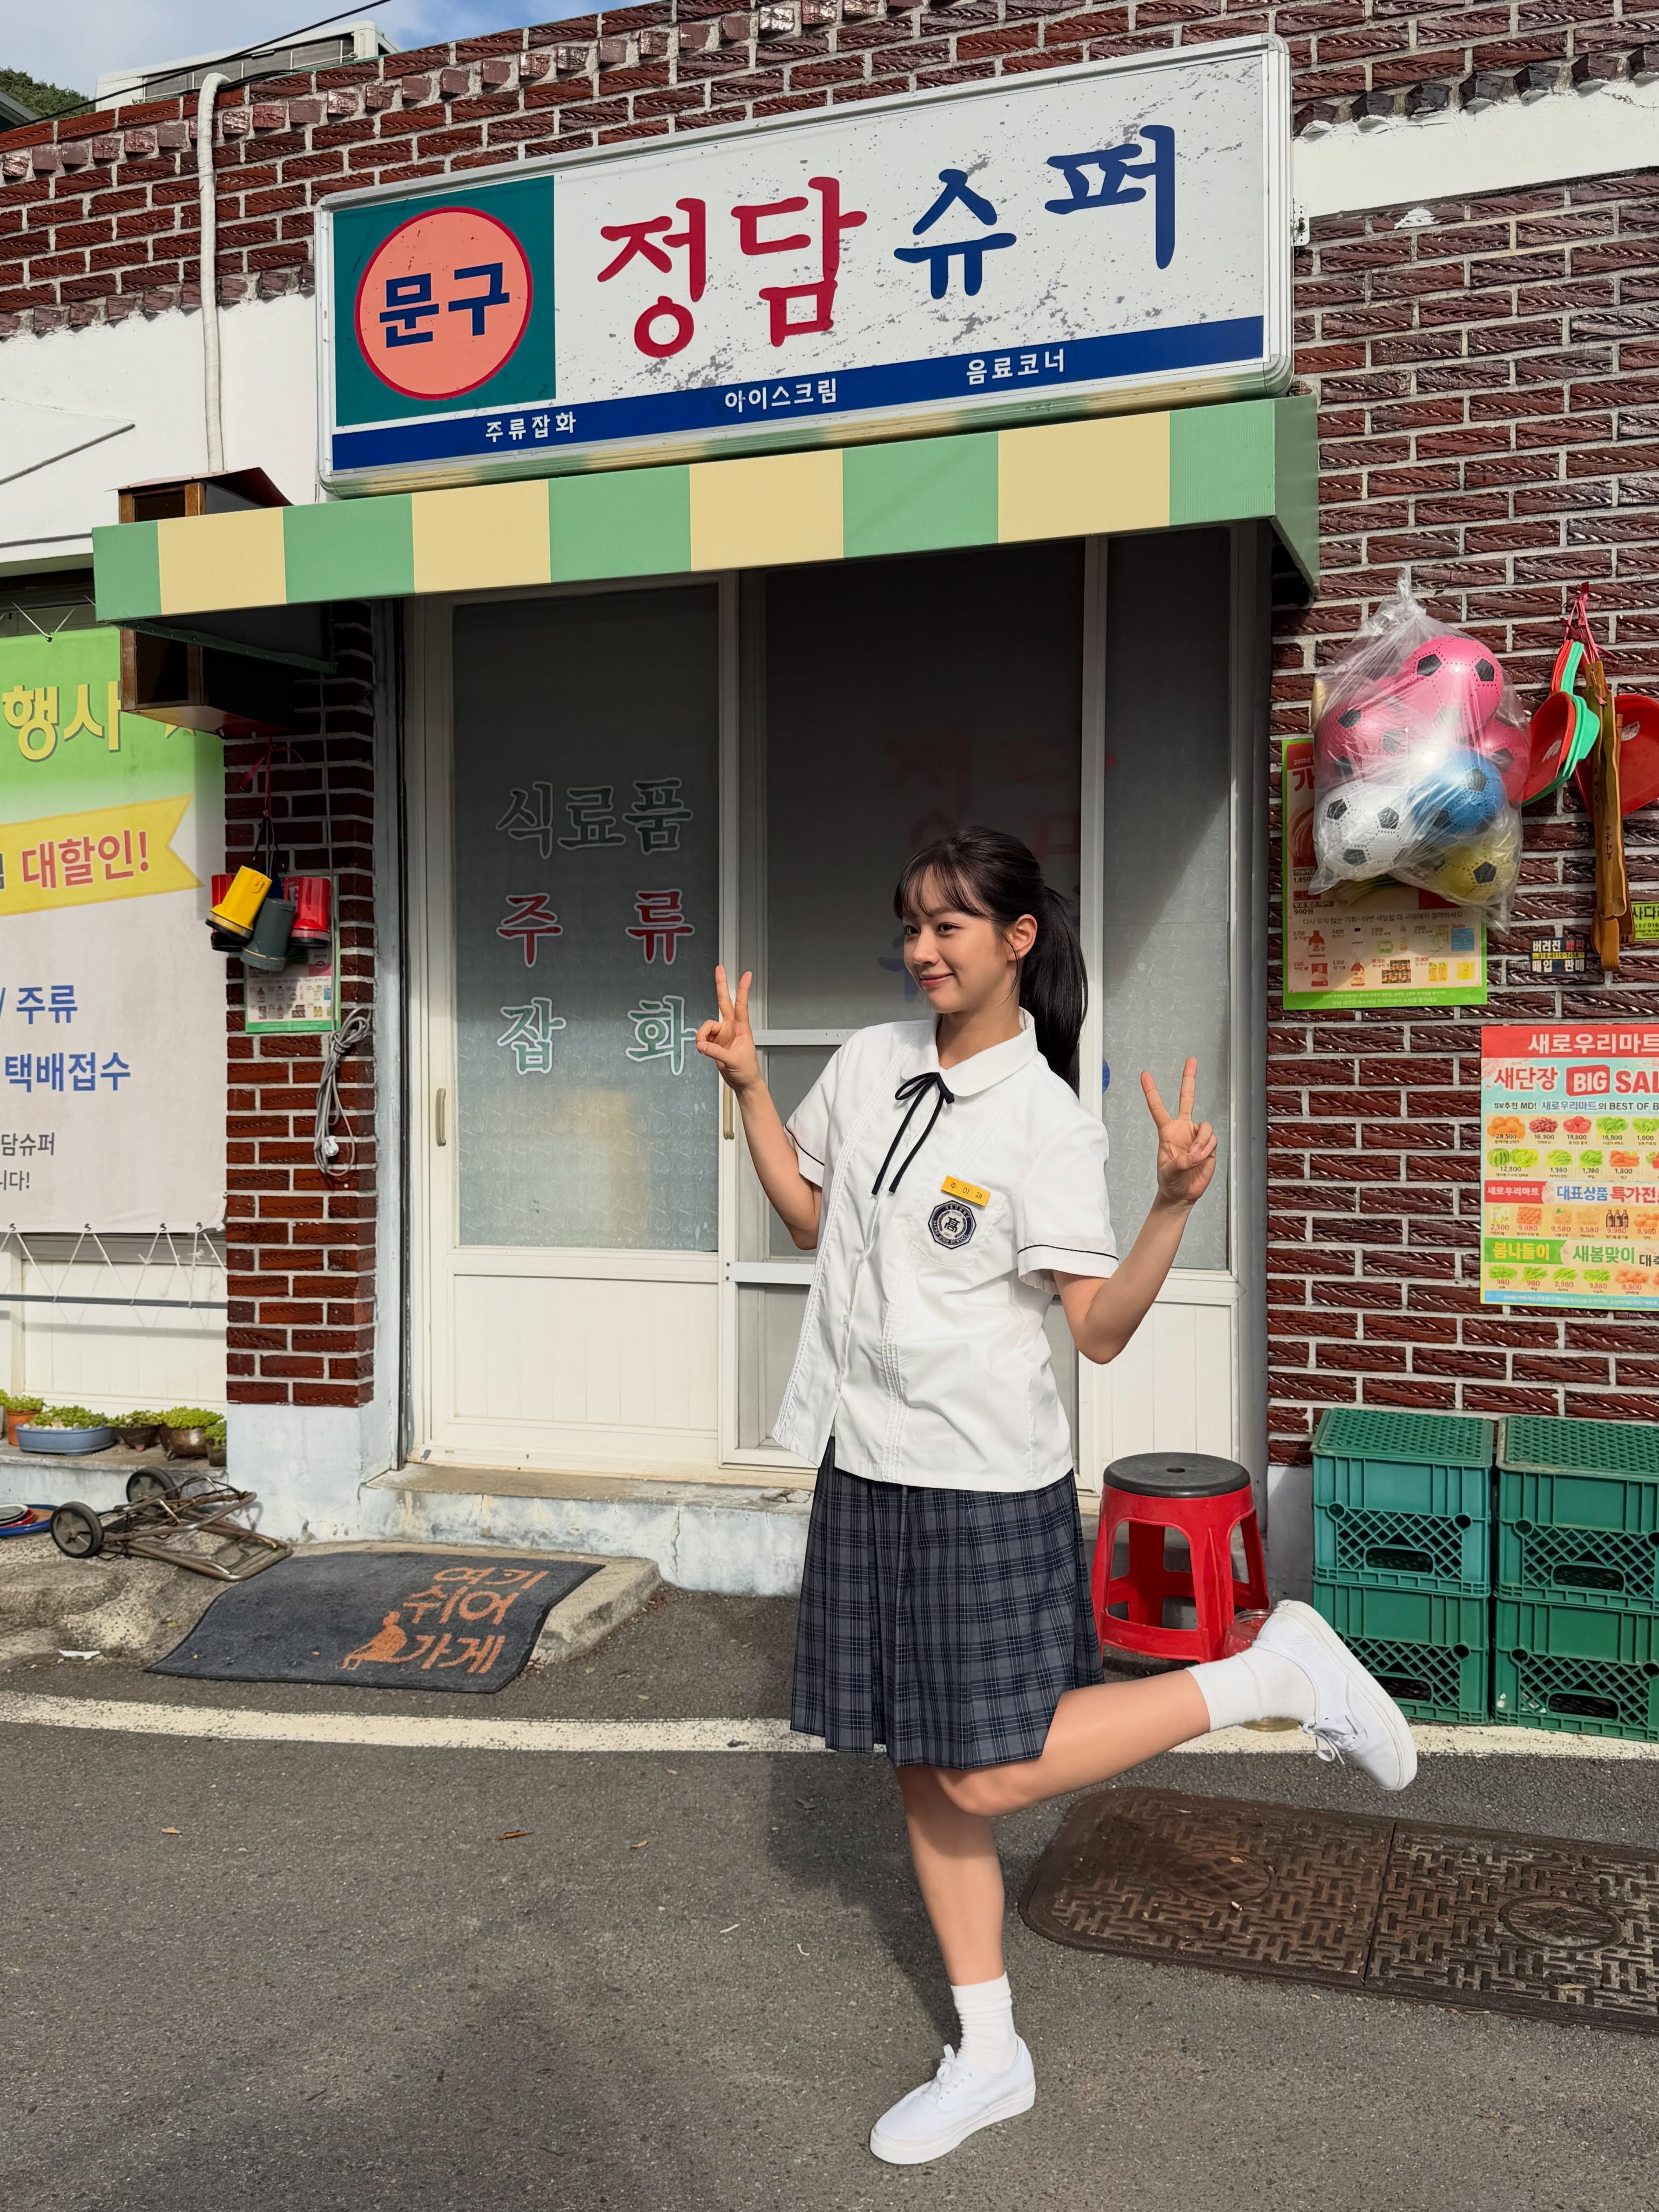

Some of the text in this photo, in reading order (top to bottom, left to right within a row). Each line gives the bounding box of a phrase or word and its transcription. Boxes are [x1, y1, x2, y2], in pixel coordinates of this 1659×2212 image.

[597, 124, 1177, 359] 정담 슈퍼
[379, 262, 510, 348] 문구
[966, 348, 1064, 386] 음료코너
[725, 377, 838, 413] 아이스크림
[485, 410, 577, 443] 주류잡화
[2, 680, 121, 761] 행사
[495, 777, 694, 860] 식료품
[22, 829, 149, 889] 대할인!
[16, 984, 78, 1024] 주류
[1527, 1033, 1659, 1054] 새로우리마트
[5, 1052, 131, 1093] 택배접수
[1493, 1067, 1559, 1091] 새단장
[1573, 1071, 1608, 1093] BIG
[1609, 1102, 1634, 1110] BEST
[1636, 1102, 1650, 1110] OF
[1, 1132, 55, 1156] 담슈퍼
[1487, 1185, 1540, 1197] 새로우리마트
[1556, 1185, 1609, 1202] 대표상품
[1493, 1242, 1550, 1261] 봄나들이
[1572, 1245, 1635, 1264] 새봄맞이
[390, 1633, 505, 1674] 가게
